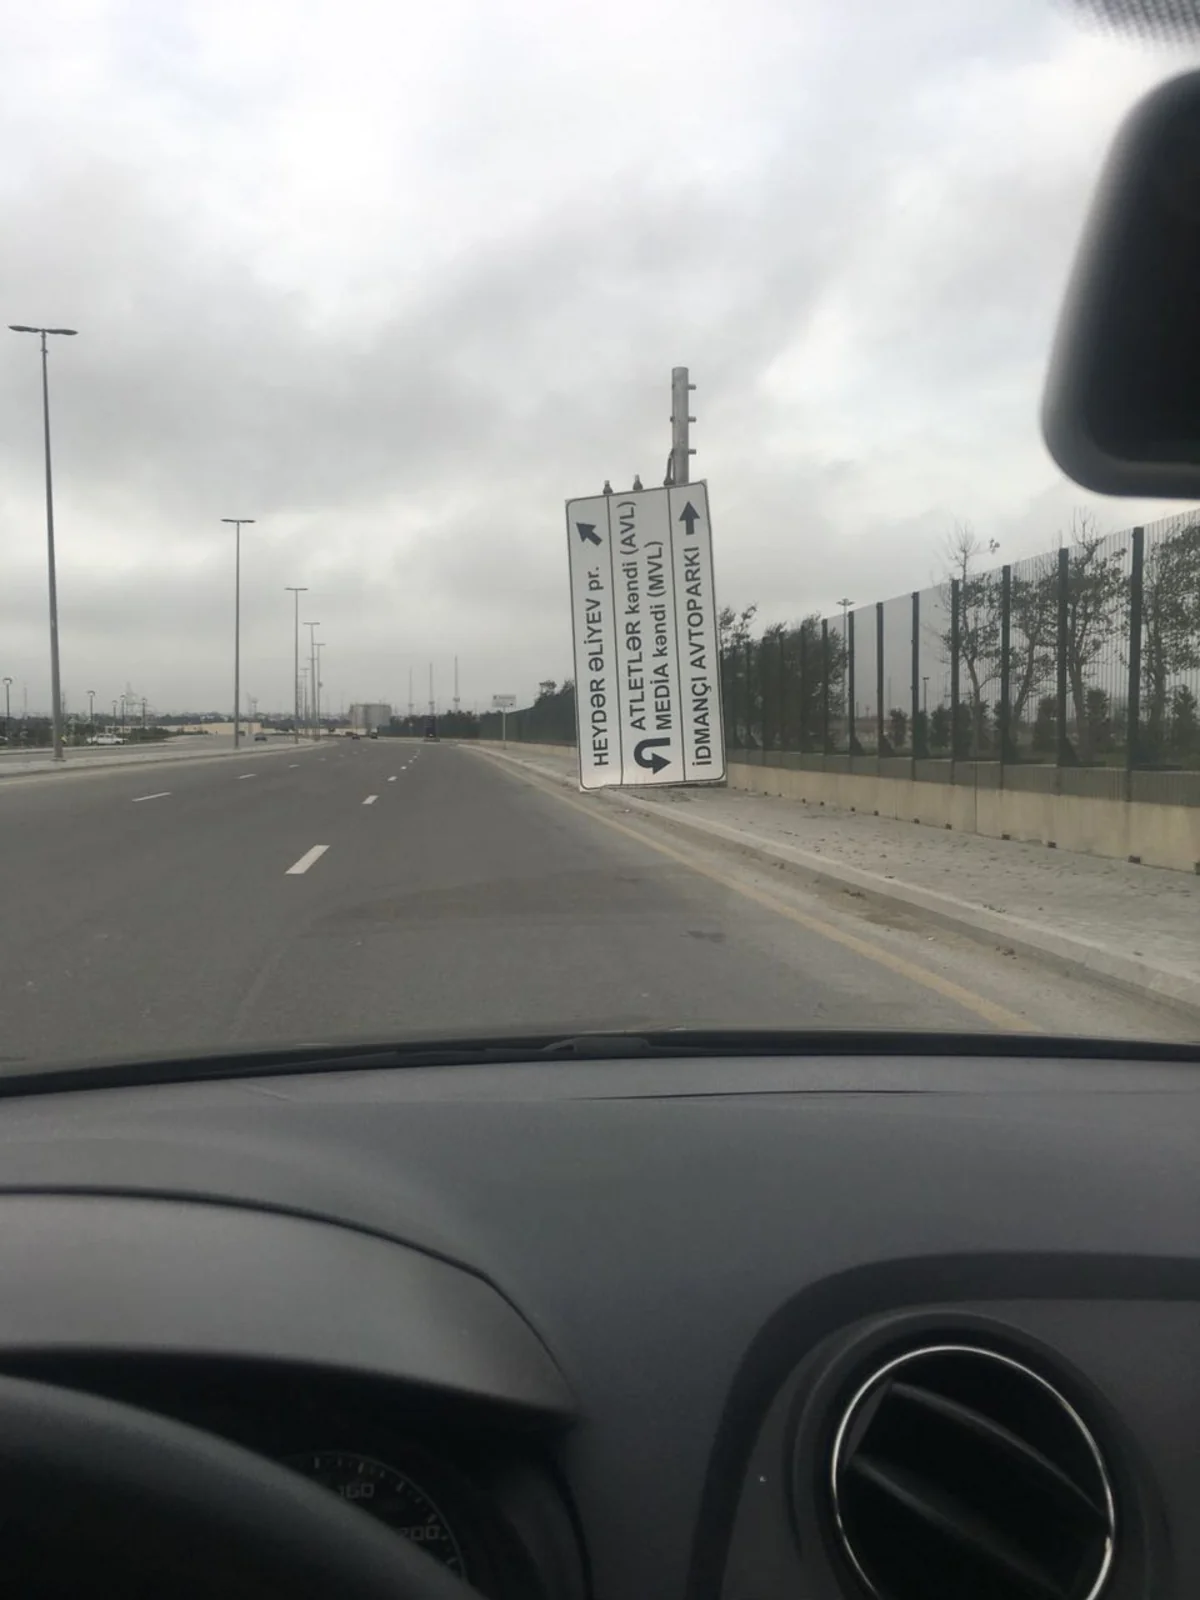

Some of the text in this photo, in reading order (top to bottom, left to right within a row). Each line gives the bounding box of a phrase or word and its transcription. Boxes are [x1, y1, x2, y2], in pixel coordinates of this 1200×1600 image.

[583, 566, 609, 766] HEYDƏR ƏLİYEV pr.
[617, 501, 646, 730] ATLETLƏR kəndi (AVL)
[644, 541, 672, 730] MEDİA kəndi (MVL)
[684, 546, 712, 766] İDMANÇI AVTOPARKI
